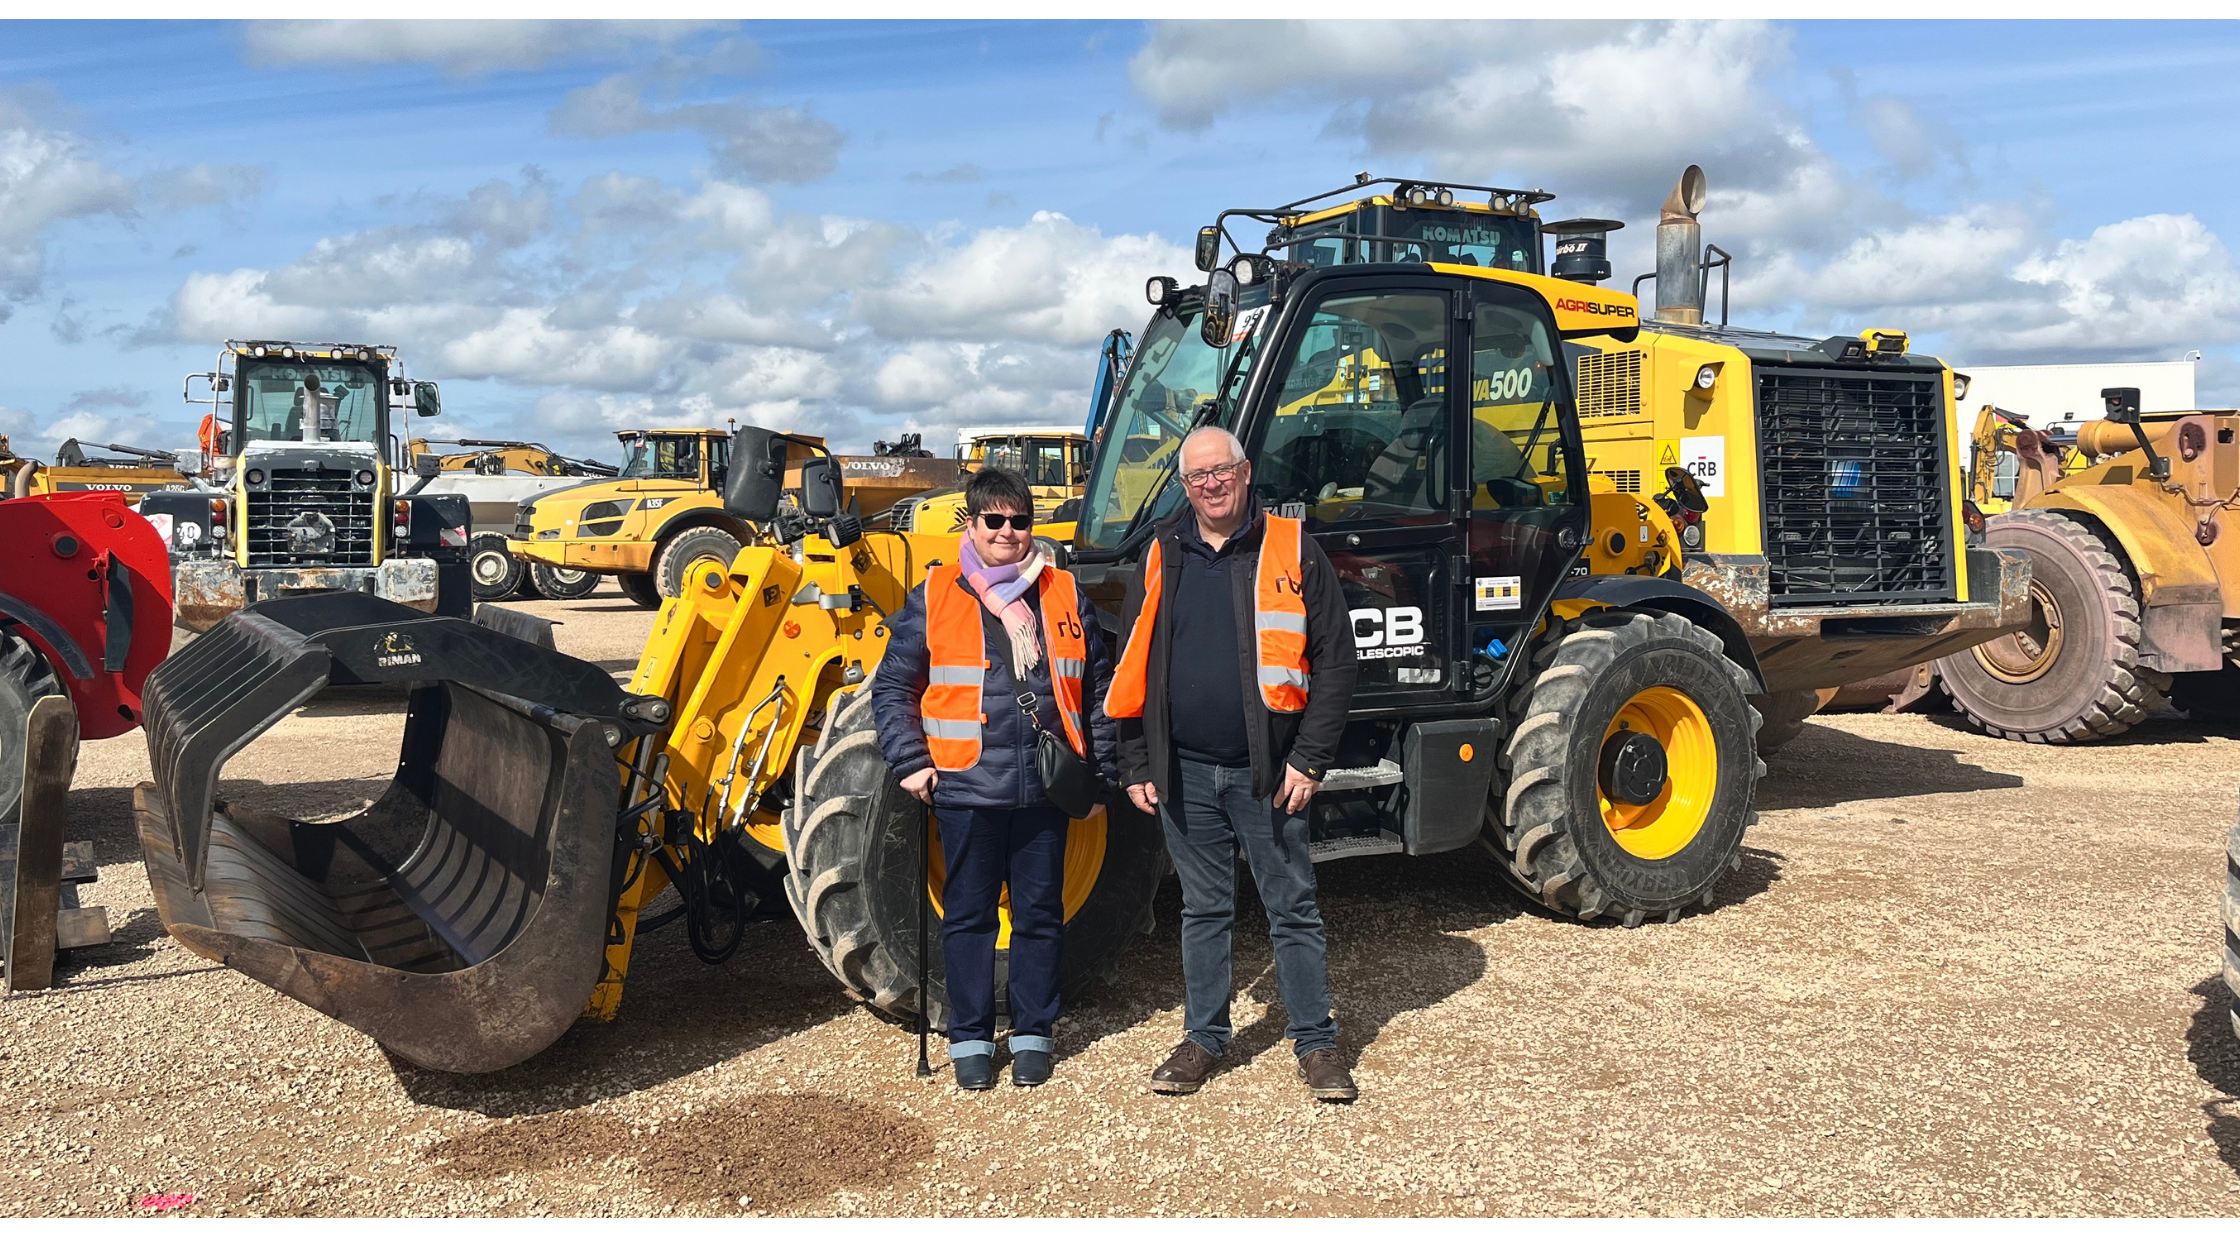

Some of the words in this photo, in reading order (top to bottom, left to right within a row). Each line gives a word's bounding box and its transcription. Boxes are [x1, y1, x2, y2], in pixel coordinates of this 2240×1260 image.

[1422, 226, 1500, 246] KOMATSU
[1555, 298, 1636, 318] AGRISUPER
[842, 461, 891, 471] VOLVO
[1687, 461, 1717, 477] CRB
[85, 483, 133, 492] VOLVO
[646, 499, 664, 509] A35F
[1057, 611, 1082, 639] rb
[1348, 606, 1424, 648] CB
[1356, 645, 1424, 660] LESCOPIC
